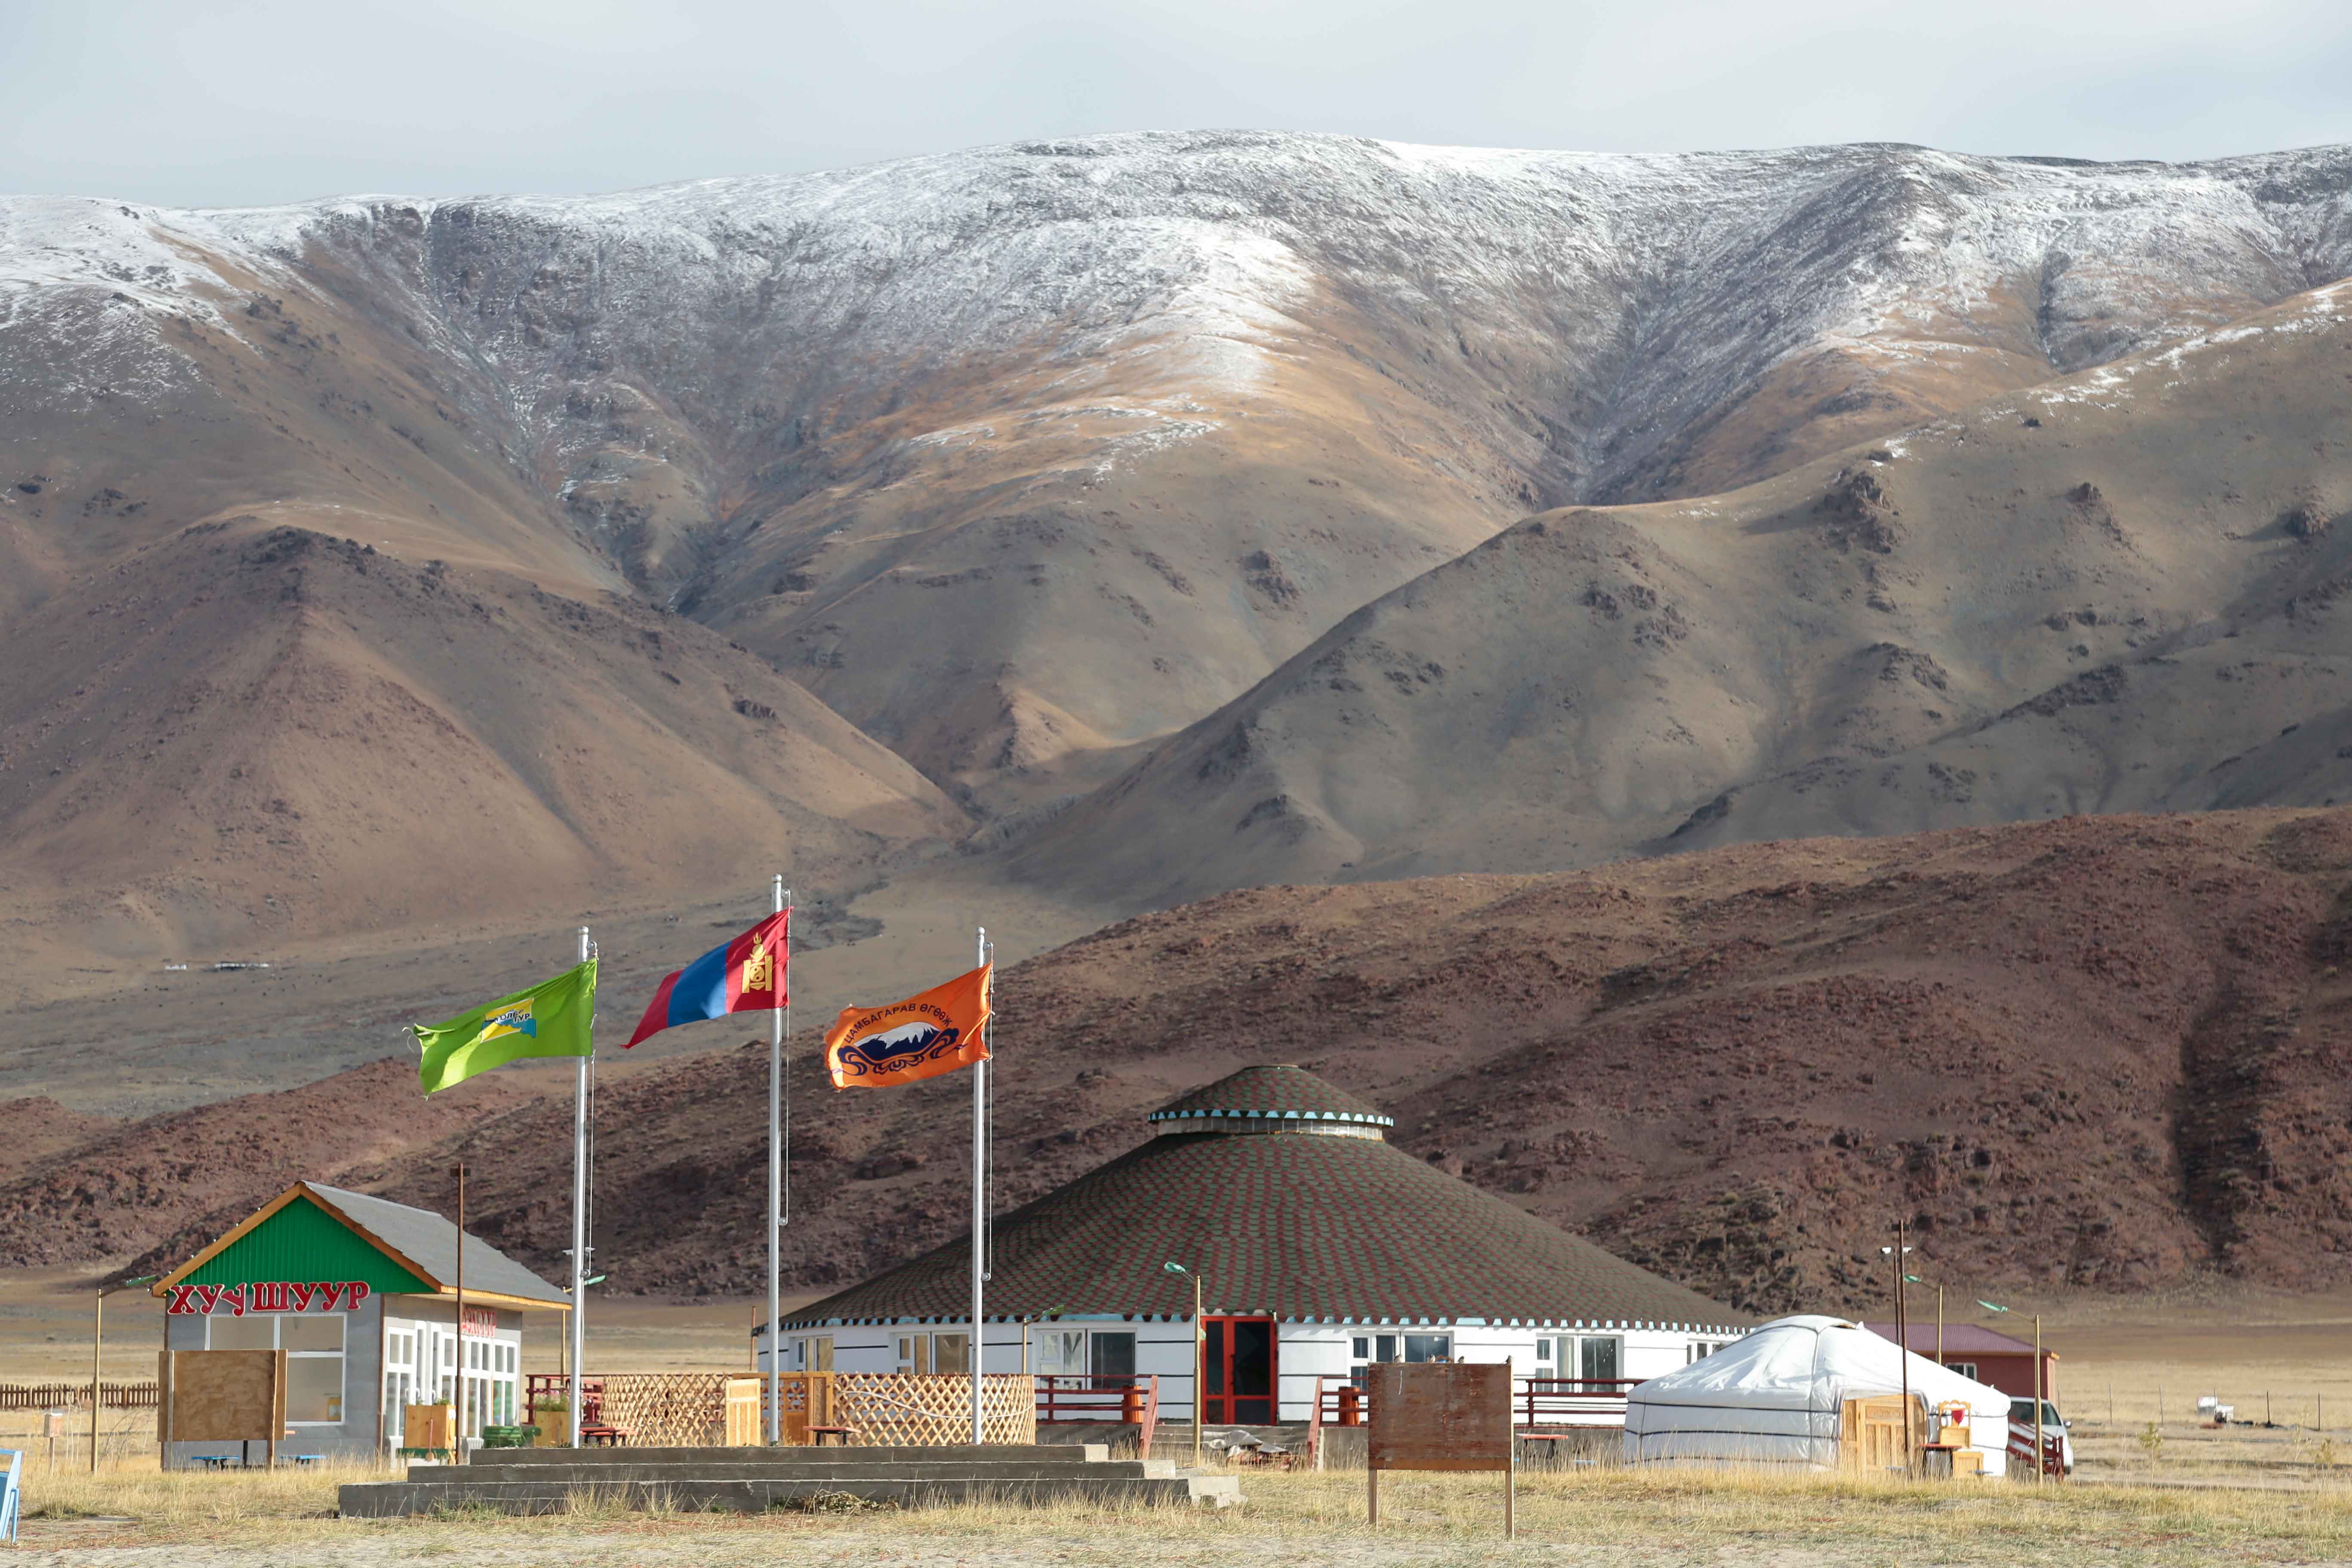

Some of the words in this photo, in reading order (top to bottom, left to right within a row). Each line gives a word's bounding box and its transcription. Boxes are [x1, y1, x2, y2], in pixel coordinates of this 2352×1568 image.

[844, 1004, 916, 1043] ЦАМБАГАРАВ
[920, 1003, 953, 1027] ӨГӨӨЖ
[167, 1281, 371, 1317] ХУУШУУР
